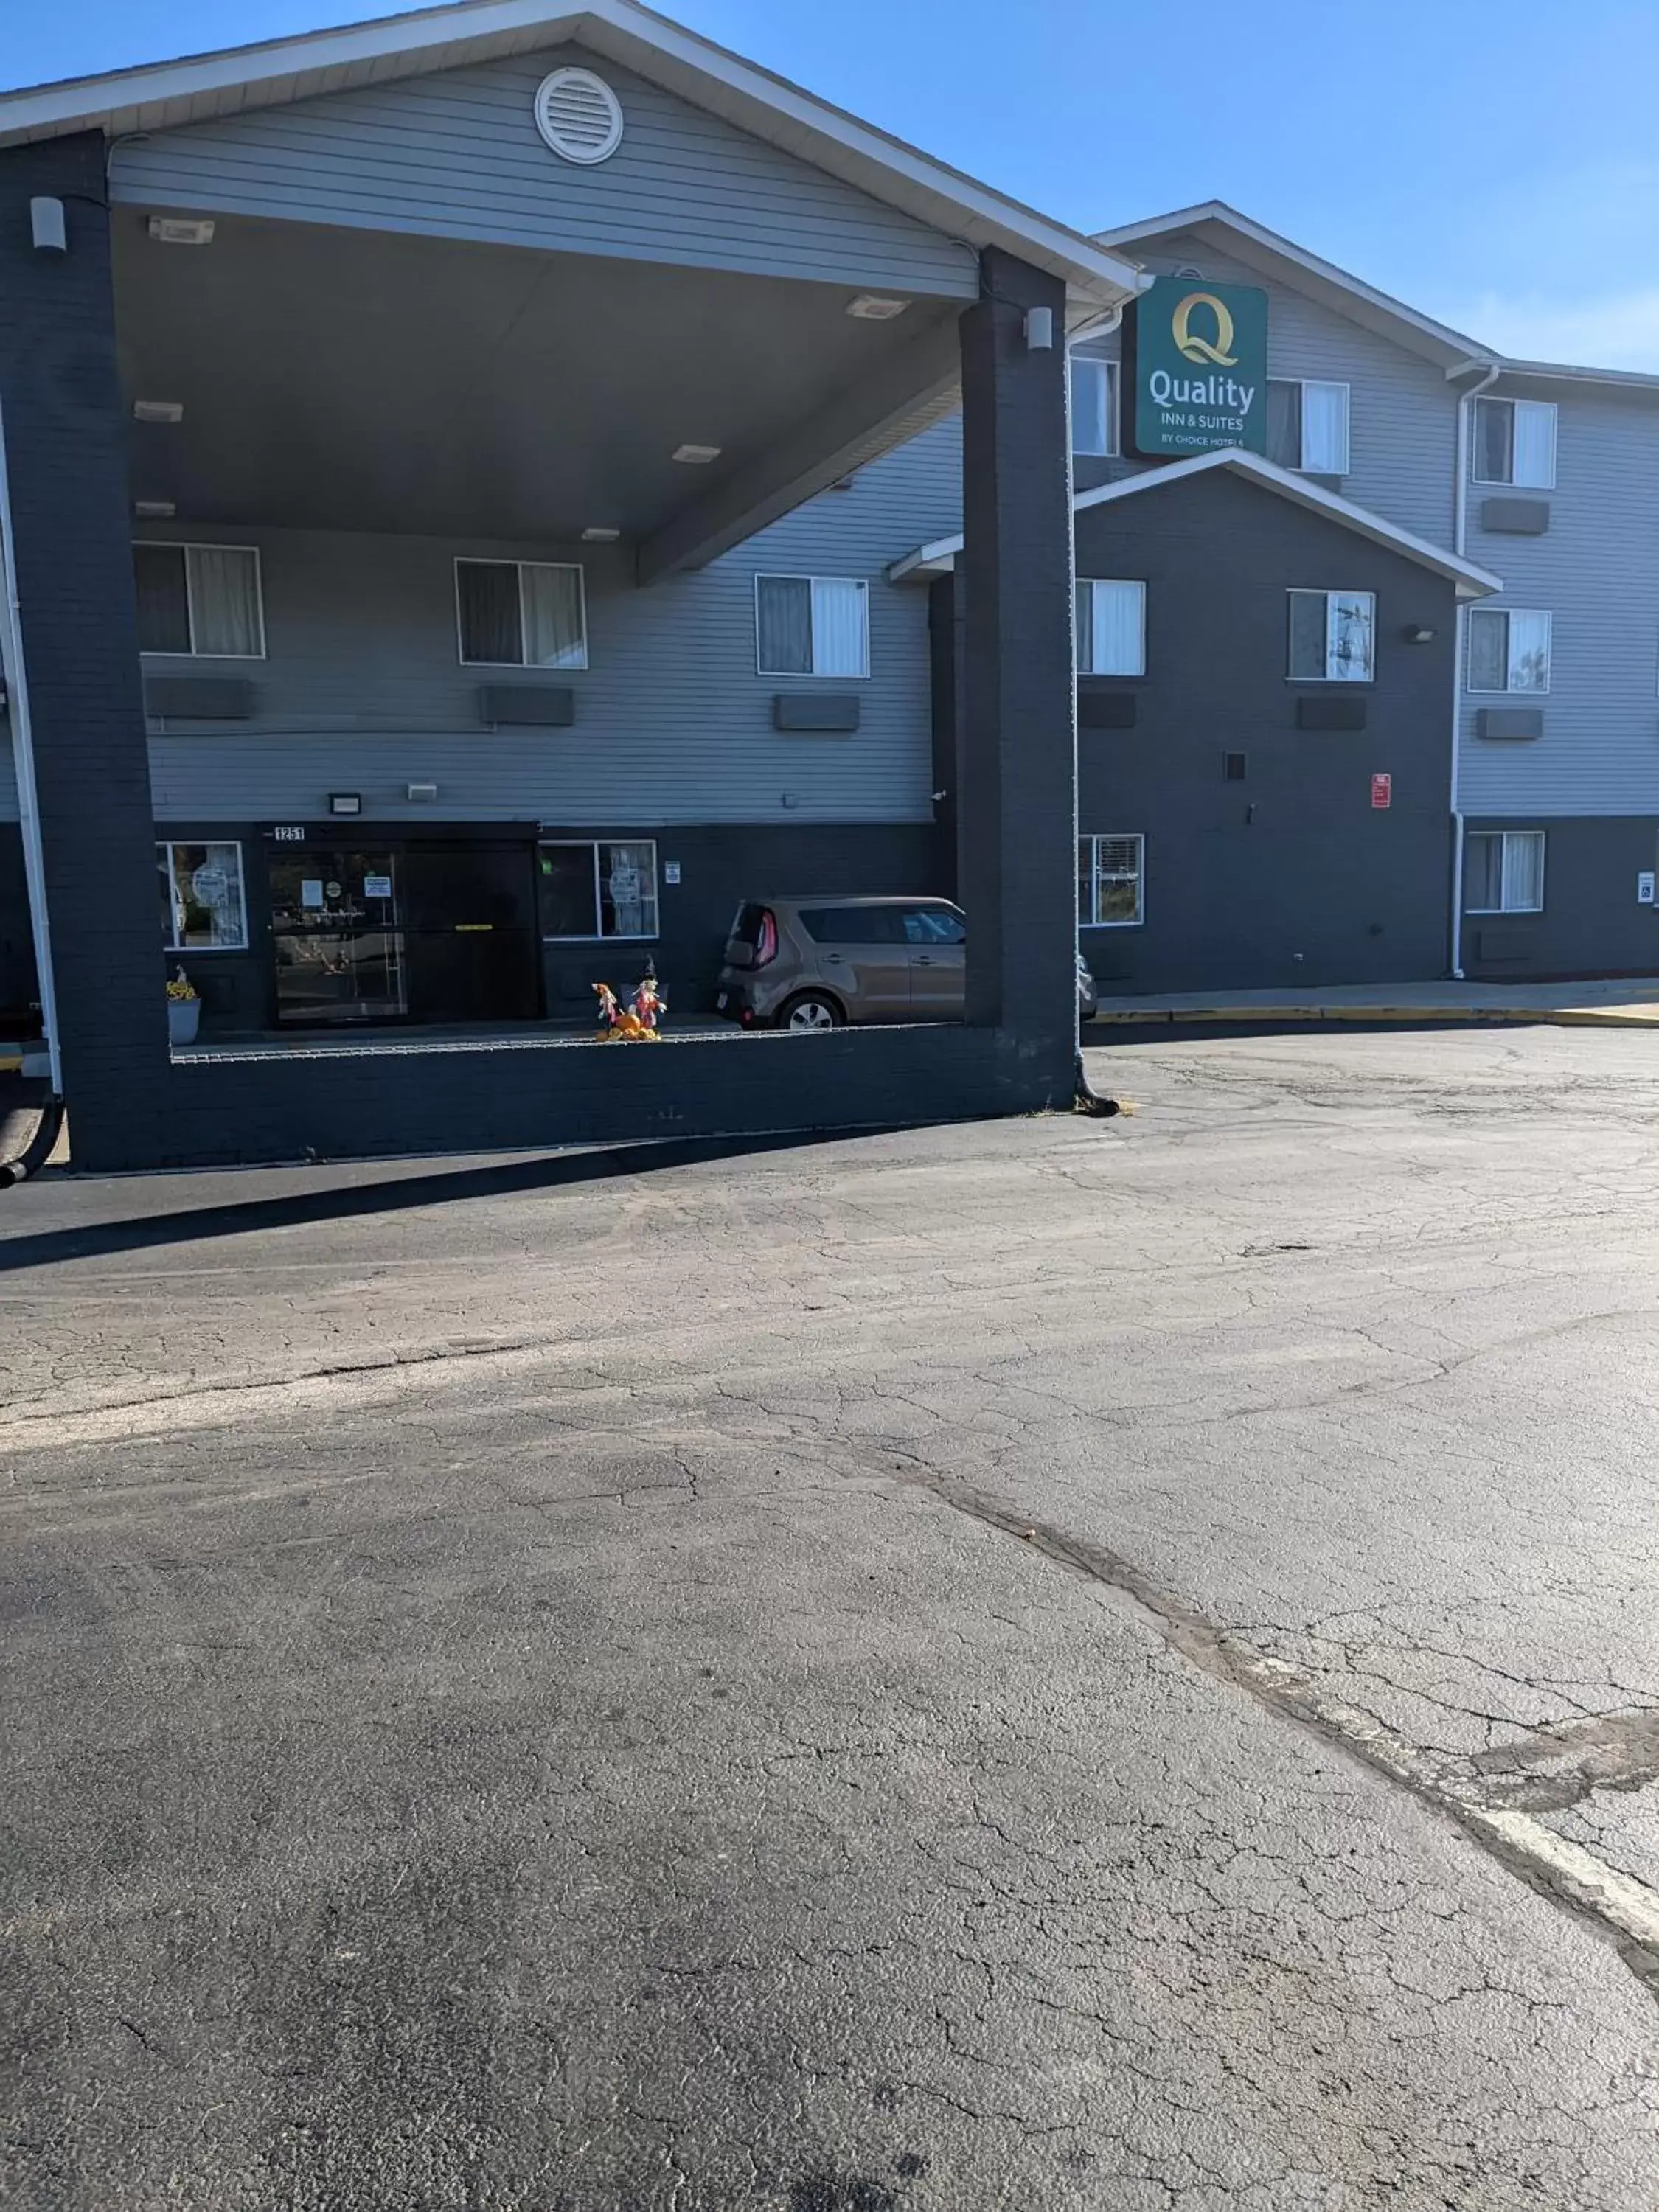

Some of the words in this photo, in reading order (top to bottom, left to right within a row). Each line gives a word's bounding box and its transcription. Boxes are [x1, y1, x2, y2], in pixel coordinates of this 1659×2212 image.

[1172, 293, 1239, 366] Q
[1149, 369, 1256, 415] Quality
[1161, 412, 1185, 425] INN
[1187, 414, 1197, 428] &
[1198, 415, 1244, 431] SUITES
[1161, 434, 1174, 444] BY
[1175, 434, 1209, 446] CHOICE
